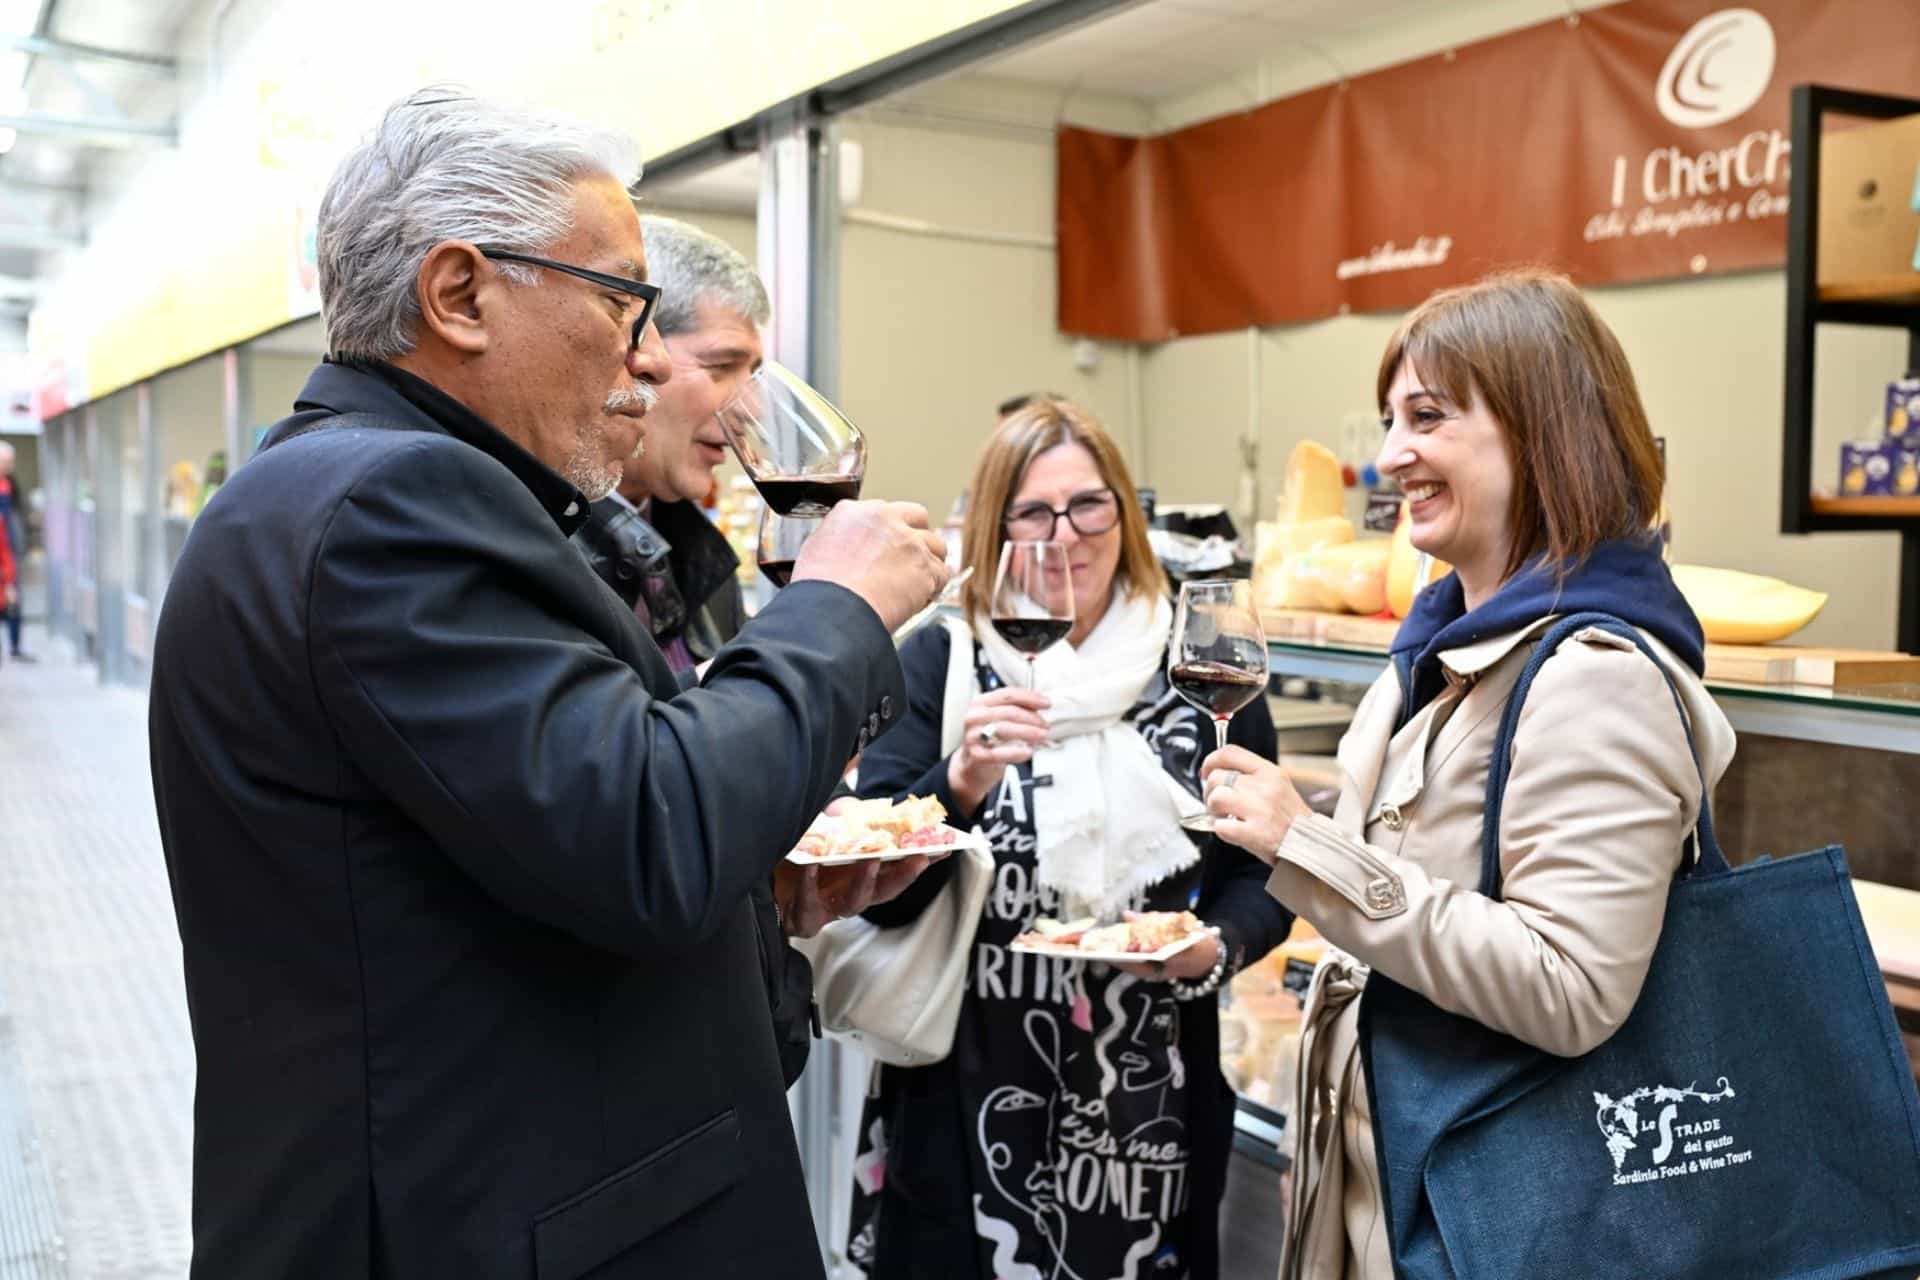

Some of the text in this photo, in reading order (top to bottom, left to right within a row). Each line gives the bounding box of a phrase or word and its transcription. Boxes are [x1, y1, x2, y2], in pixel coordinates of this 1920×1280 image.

[1612, 154, 1627, 208] I
[1705, 1135, 1734, 1152] gusto
[1612, 1150, 1752, 1185] Sardinia Food & Wine Tours
